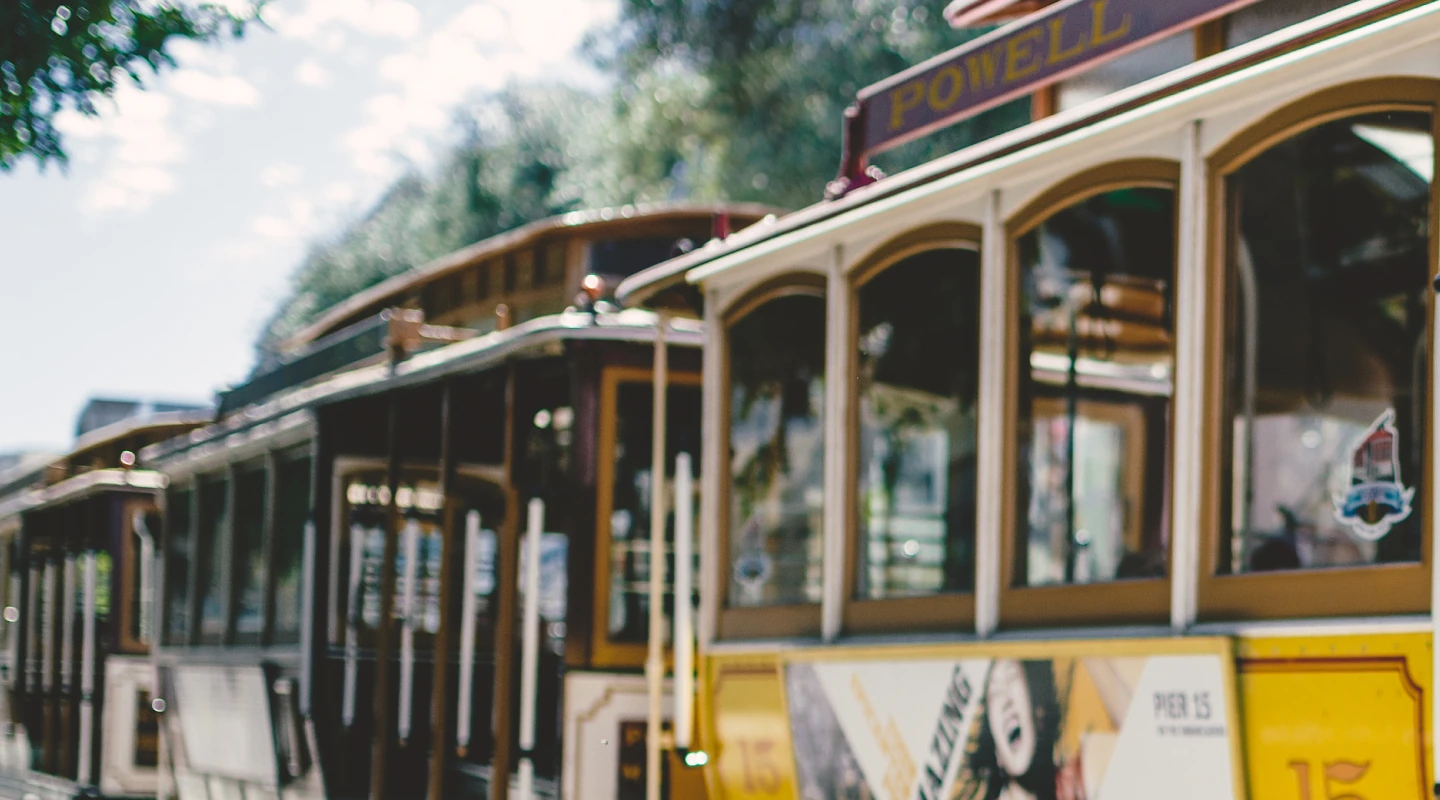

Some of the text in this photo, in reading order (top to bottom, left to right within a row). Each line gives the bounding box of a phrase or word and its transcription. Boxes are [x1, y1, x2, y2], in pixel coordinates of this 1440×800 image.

[889, 1, 1131, 130] POWELL
[1153, 690, 1211, 719] PIER 15
[739, 738, 782, 795] 15
